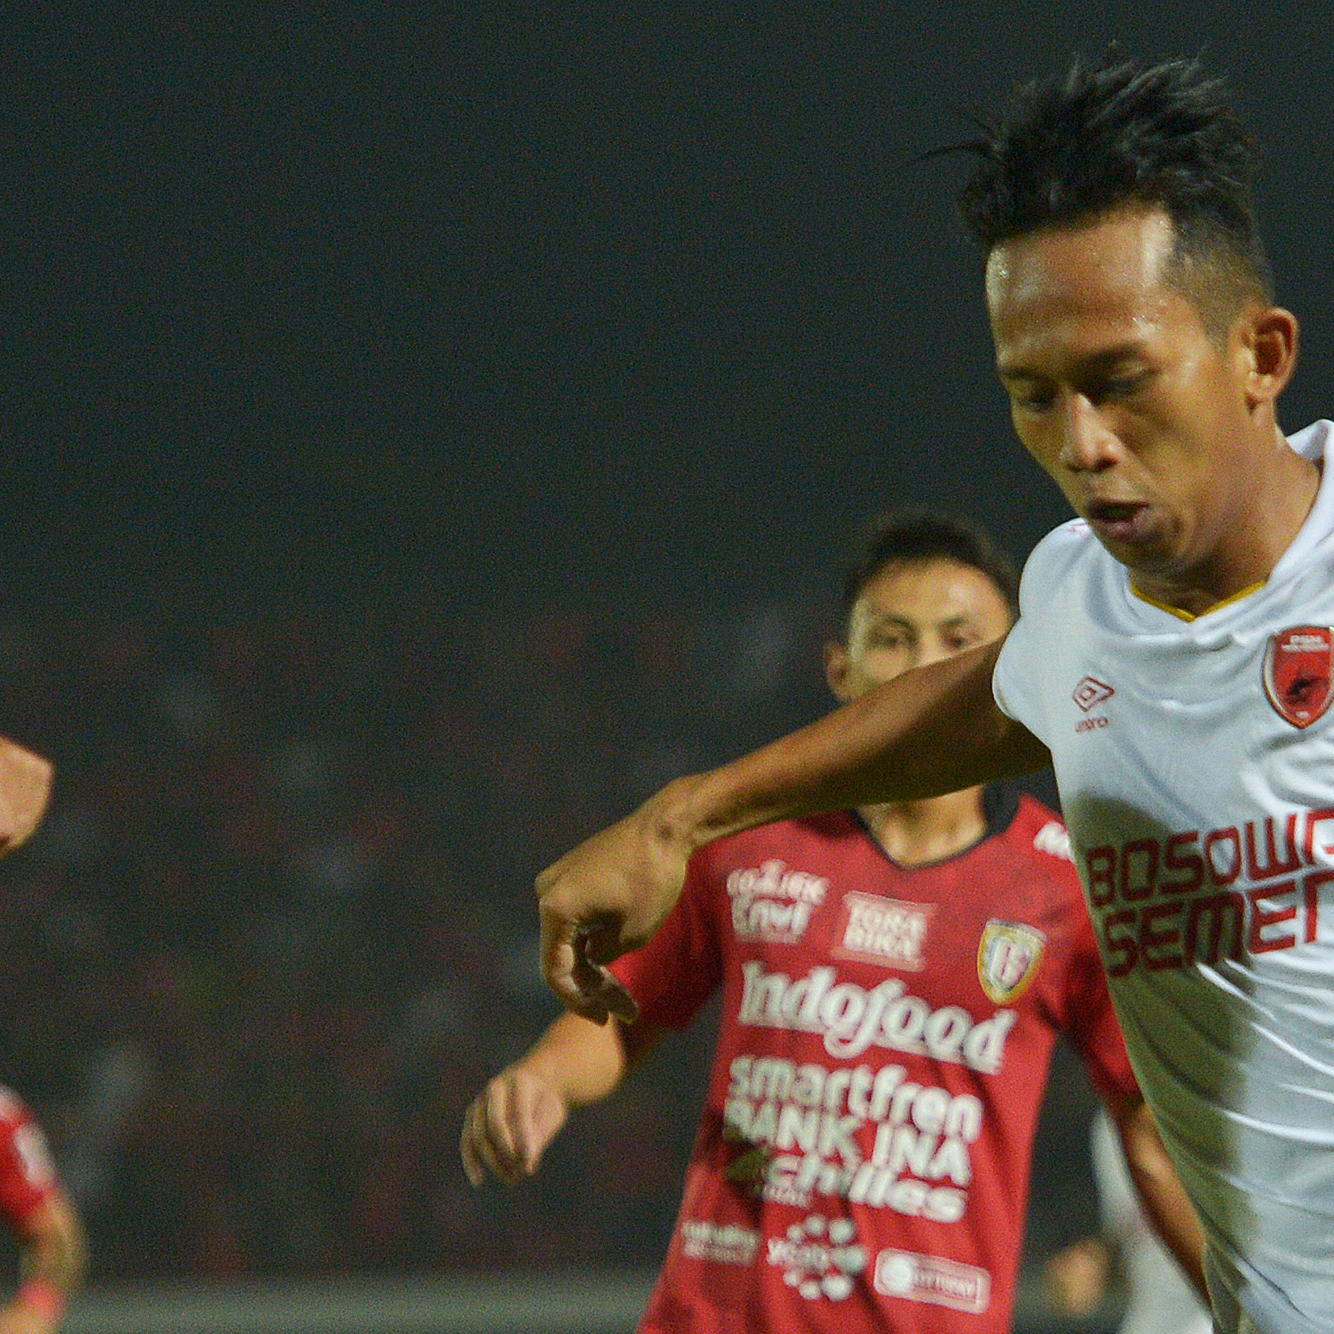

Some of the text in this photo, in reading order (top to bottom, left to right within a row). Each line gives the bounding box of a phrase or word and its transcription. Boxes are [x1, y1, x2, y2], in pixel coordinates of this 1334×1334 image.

[736, 960, 1018, 1075] Indofood
[723, 1099, 972, 1186] BANK INA
[728, 1053, 984, 1144] smartfren
